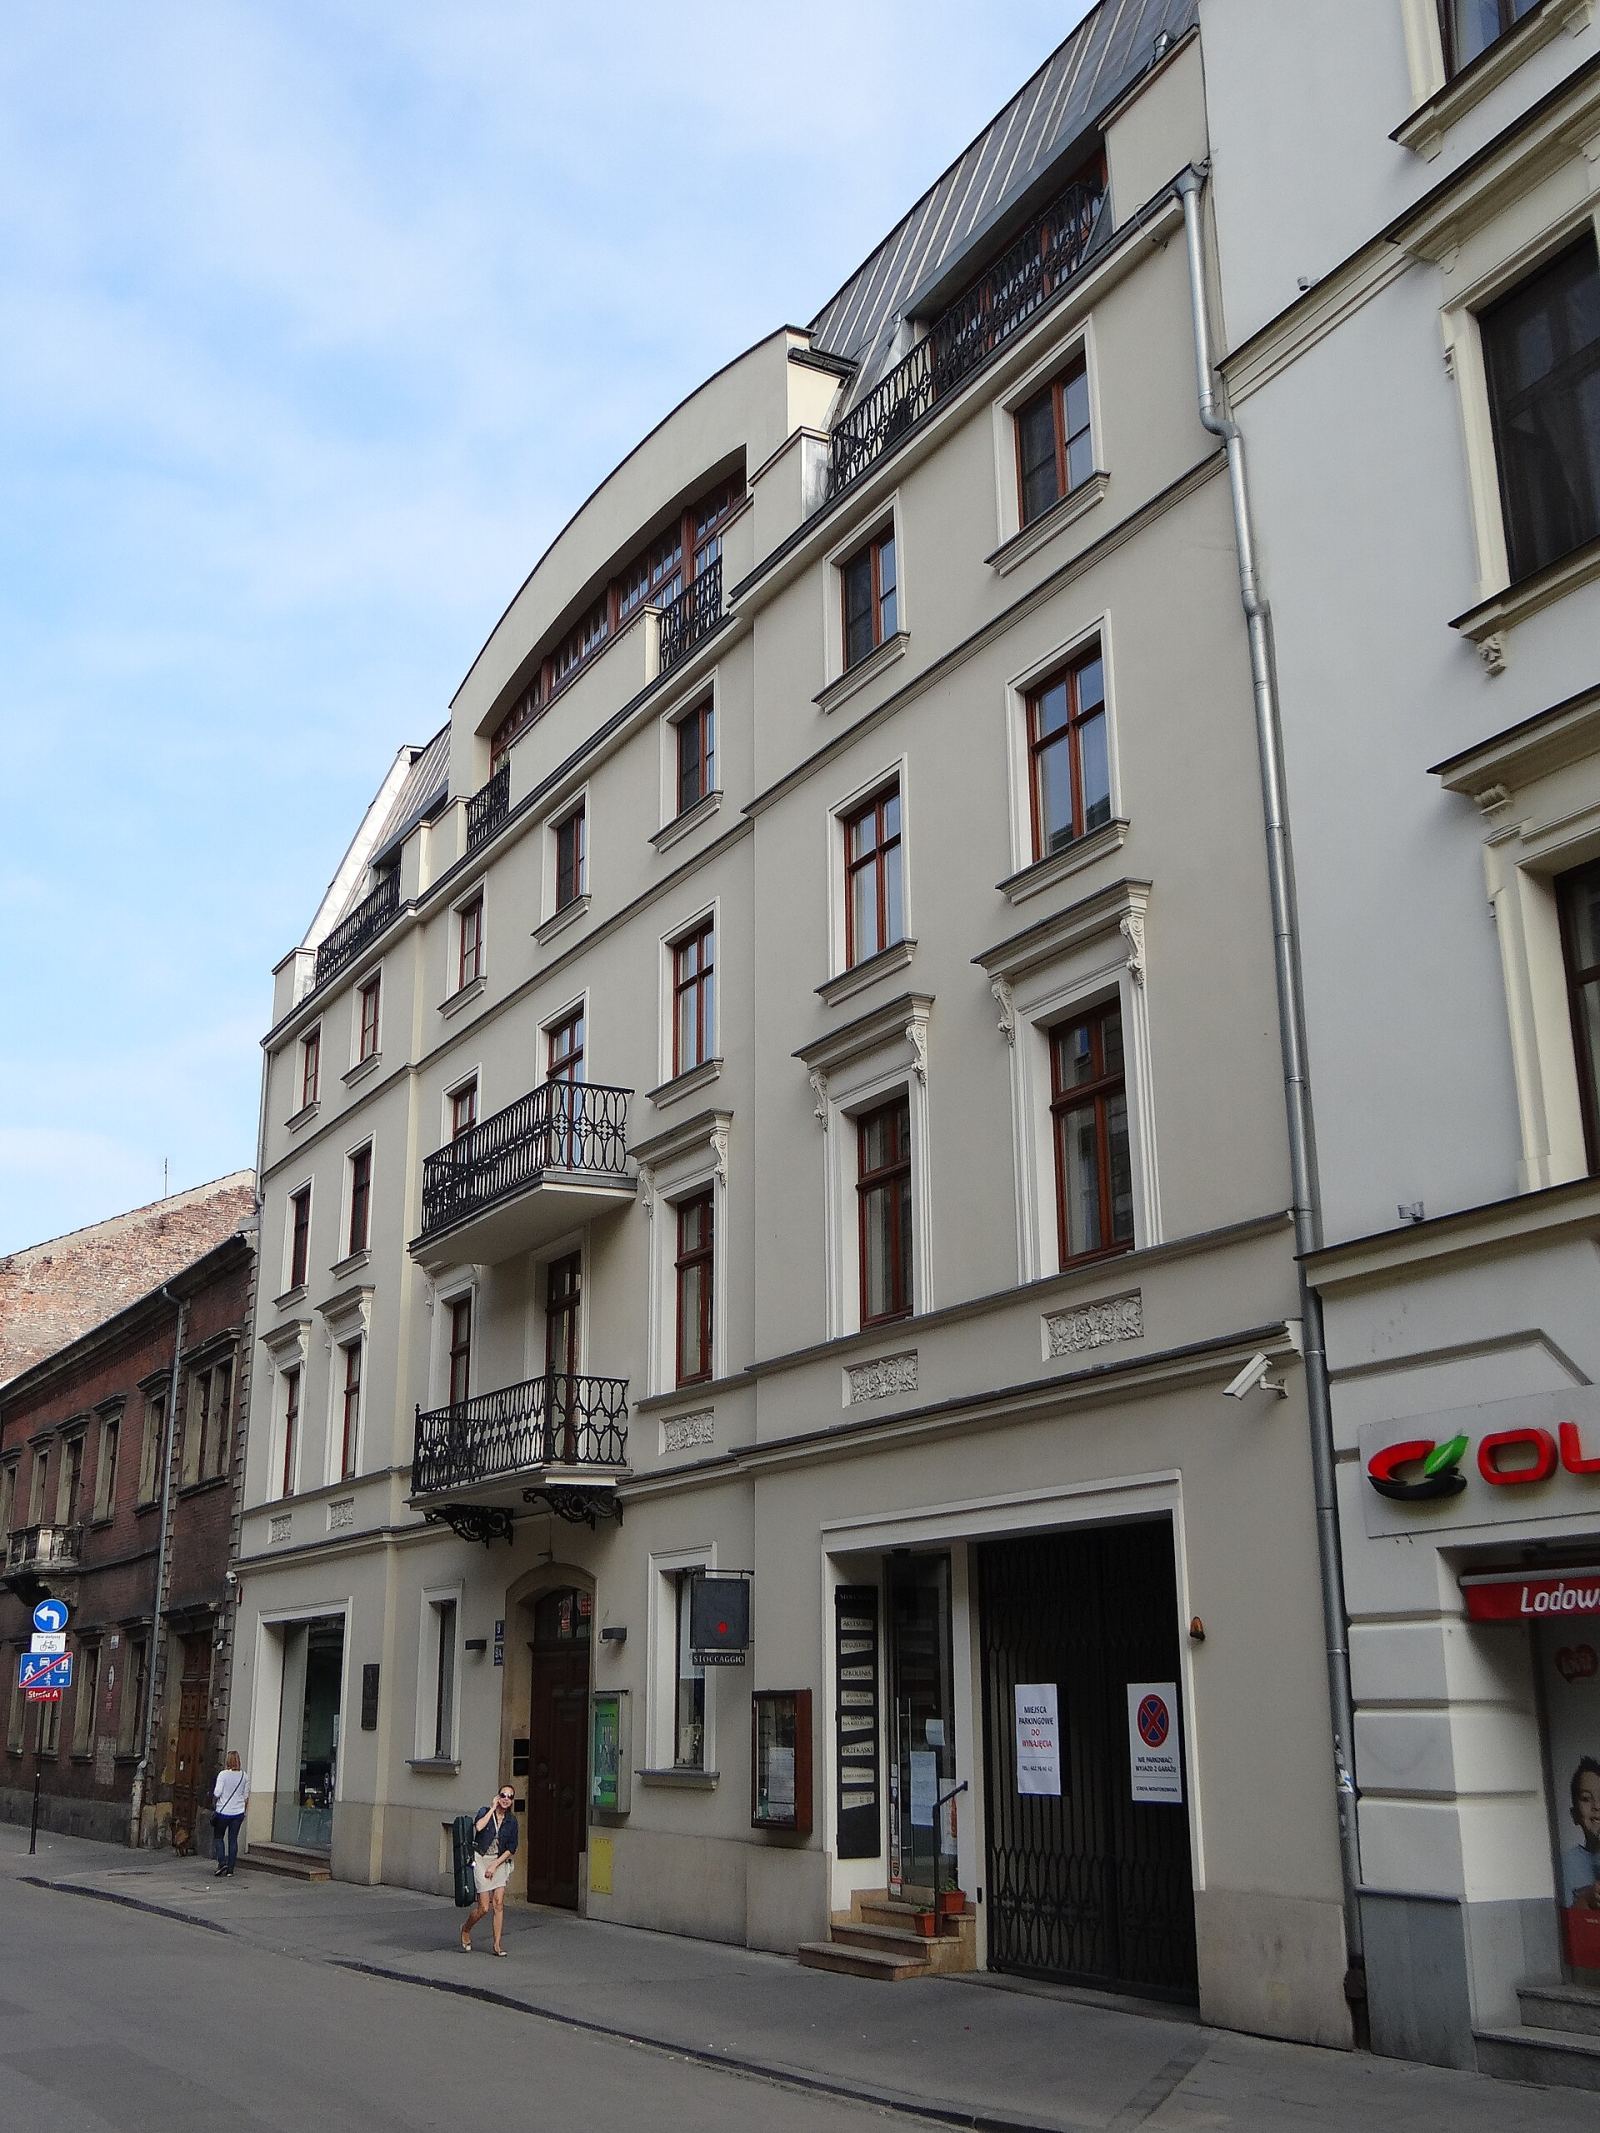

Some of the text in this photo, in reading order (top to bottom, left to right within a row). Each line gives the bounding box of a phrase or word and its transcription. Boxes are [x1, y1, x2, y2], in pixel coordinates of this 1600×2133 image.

[1520, 1582, 1600, 1613] Lodow
[694, 1655, 744, 1663] STOCCAGGIO
[1024, 1706, 1047, 1714] MIEJSCA
[1018, 1717, 1054, 1725] PARKINGOWE
[1022, 1740, 1053, 1749] WYNAJĘCIA
